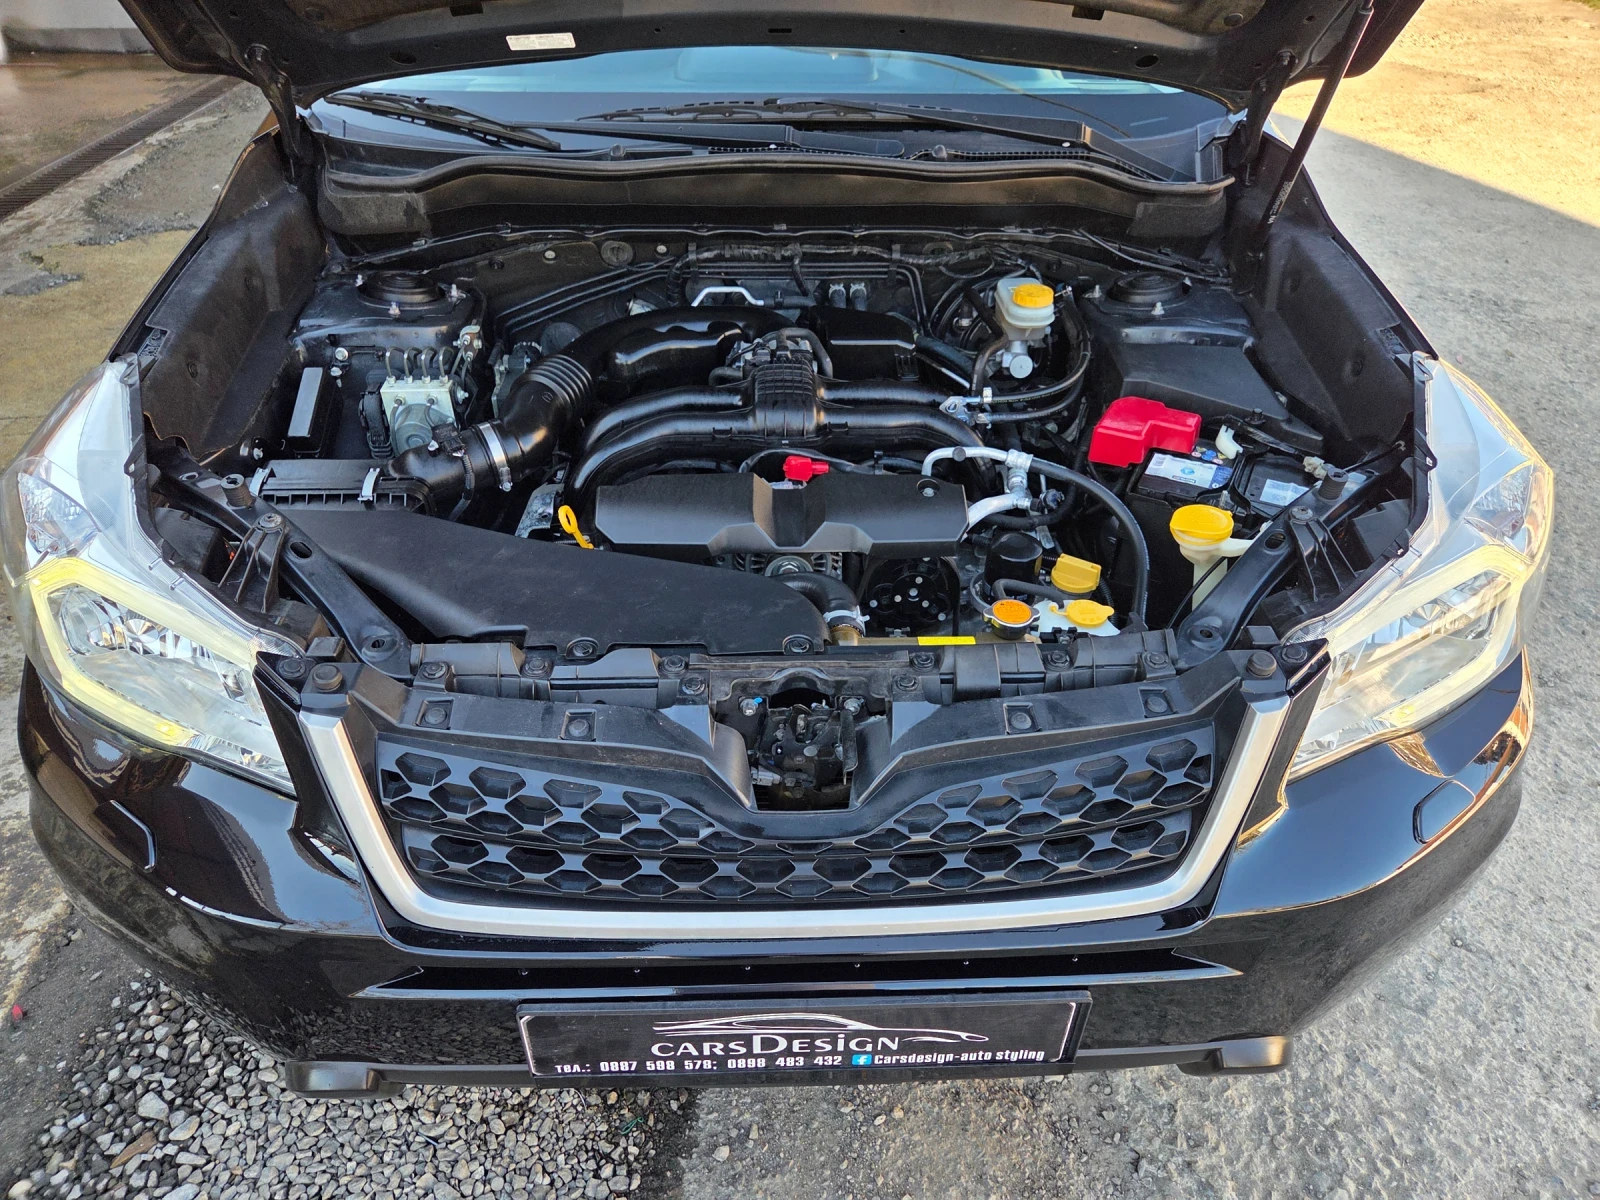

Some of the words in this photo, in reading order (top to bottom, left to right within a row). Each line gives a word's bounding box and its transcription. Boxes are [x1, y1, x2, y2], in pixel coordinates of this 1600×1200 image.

[600, 1061, 637, 1072] 0887
[646, 1060, 675, 1071] 598
[727, 1057, 766, 1069] 0898
[775, 1056, 804, 1067] 483
[814, 1055, 843, 1066] 432
[874, 1052, 992, 1064] Carsdesign-auto
[996, 1049, 1045, 1062] styling
